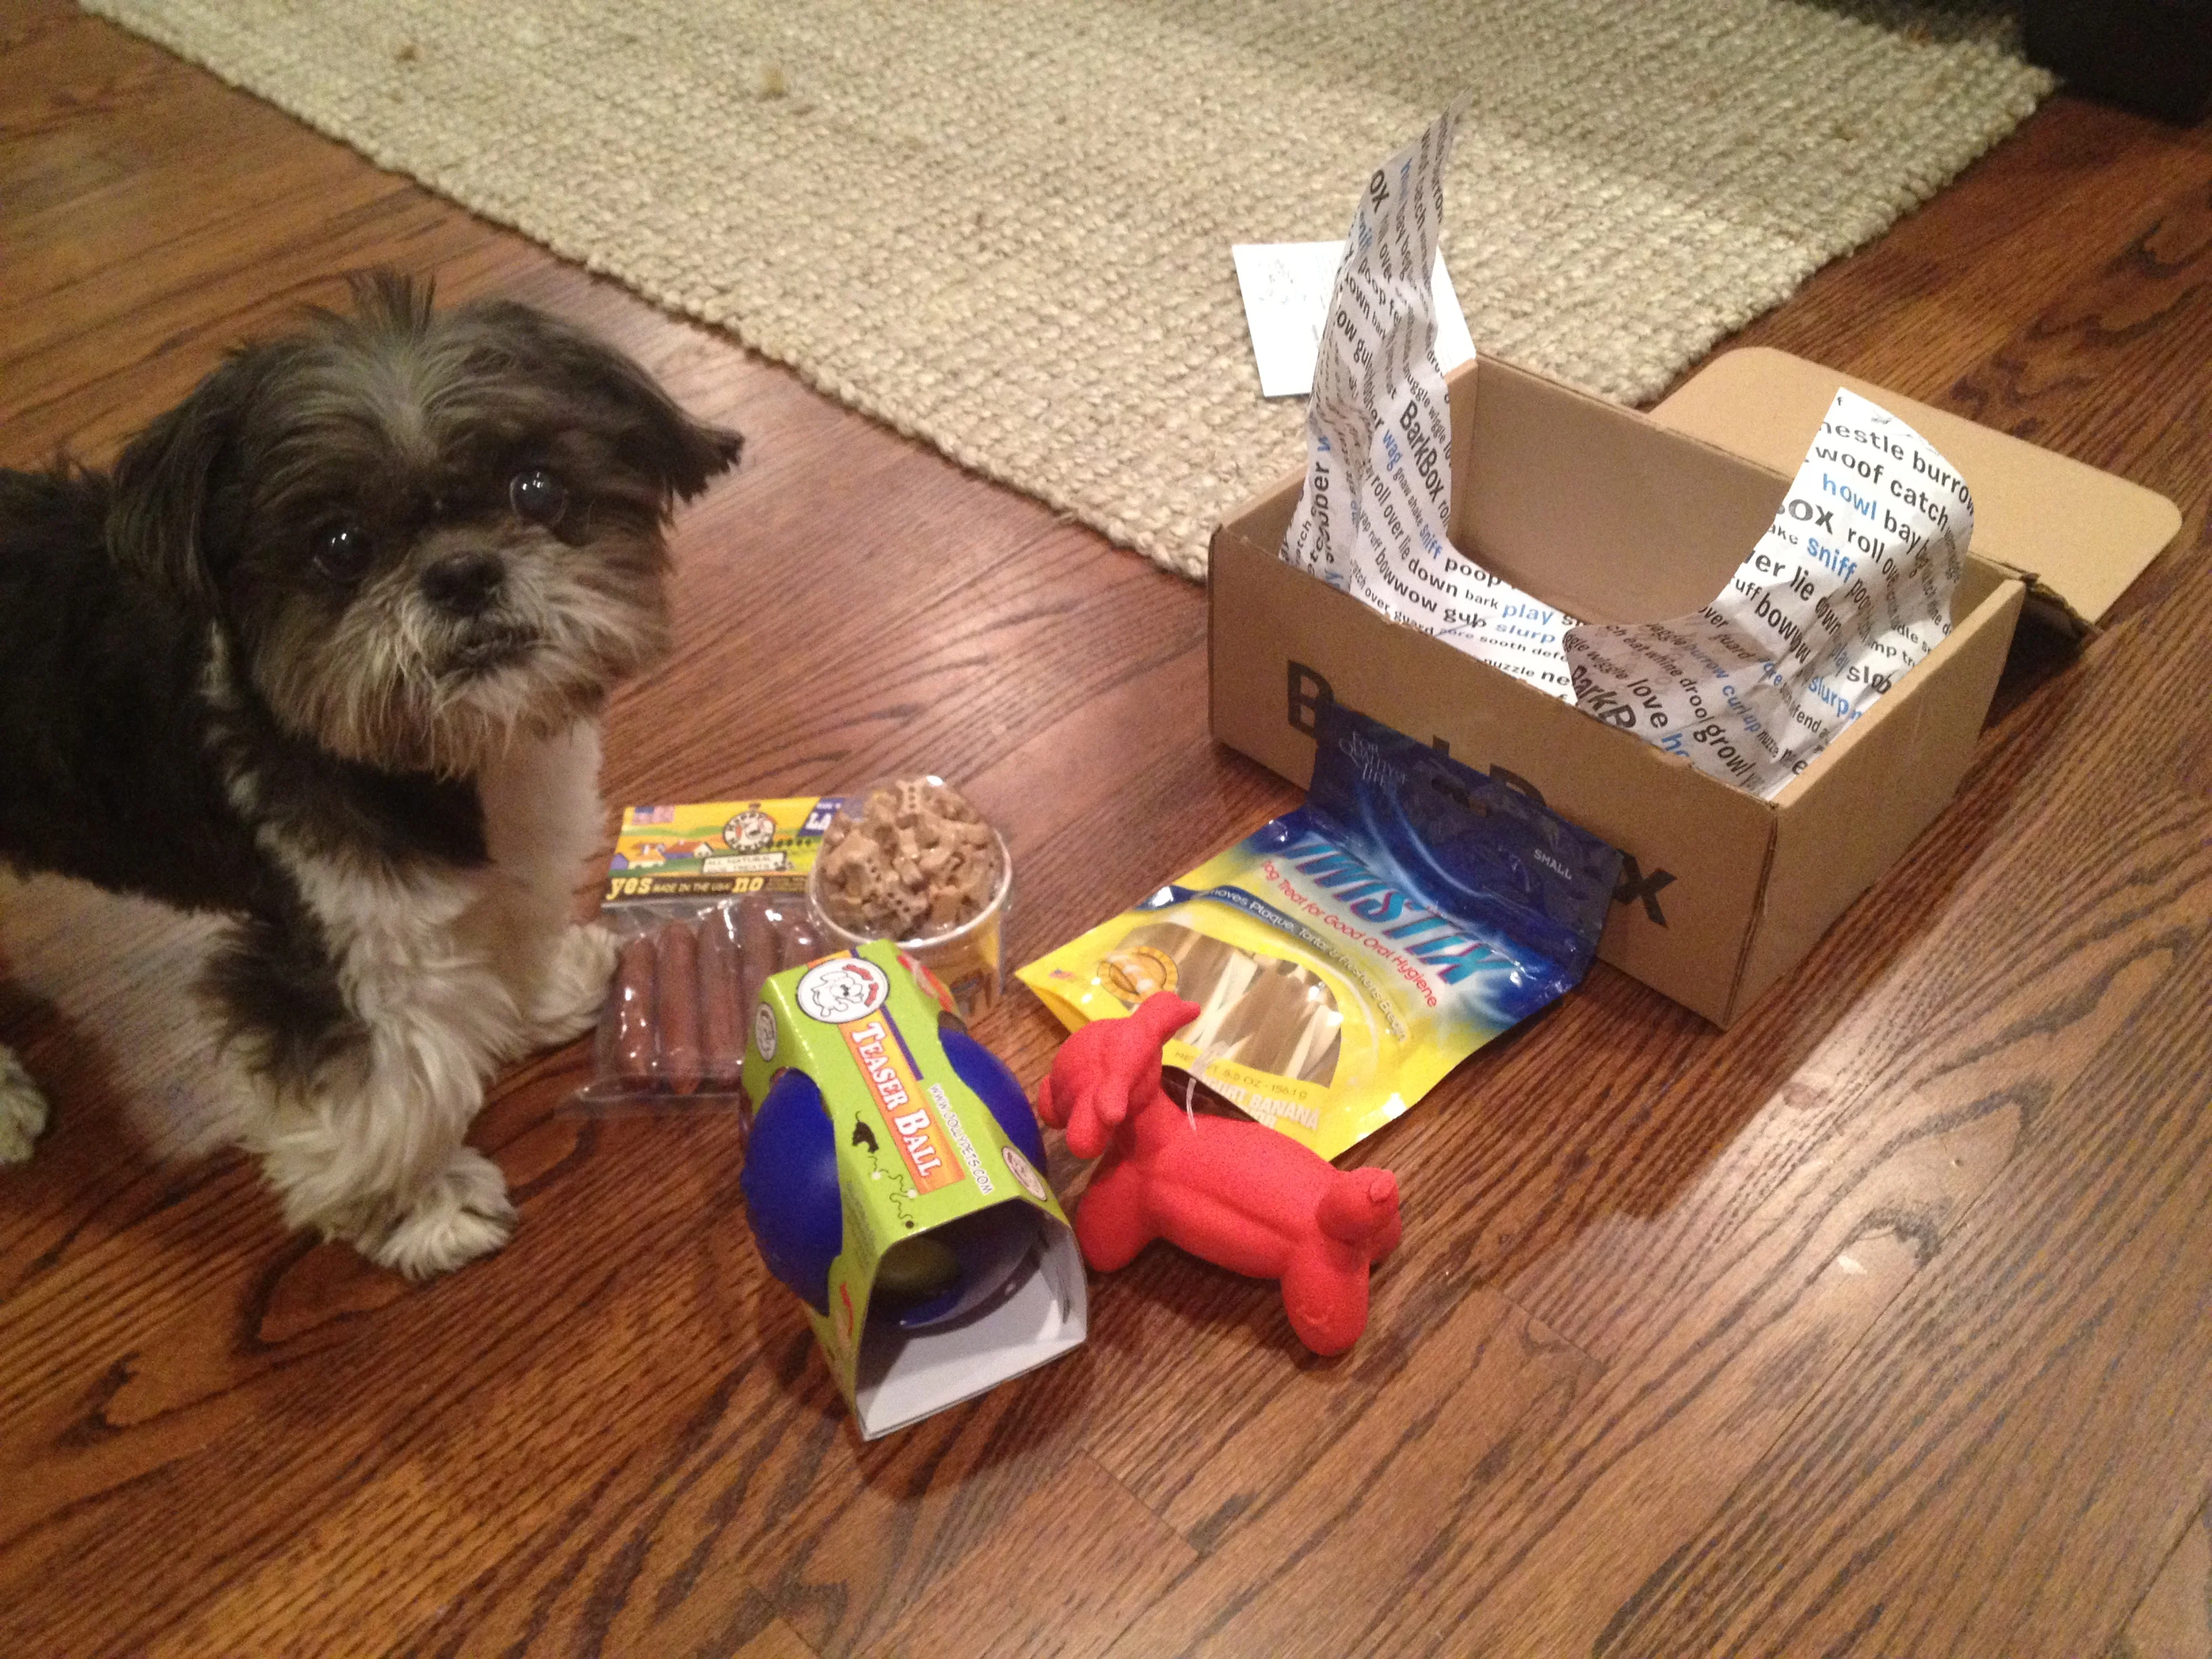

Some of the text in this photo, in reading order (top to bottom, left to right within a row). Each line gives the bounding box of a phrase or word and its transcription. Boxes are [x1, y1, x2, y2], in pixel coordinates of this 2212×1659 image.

[1399, 398, 1444, 504] BarkBox
[1382, 428, 1403, 472] wag
[1393, 466, 1412, 497] gnaw
[1408, 495, 1423, 527] shake
[1420, 523, 1443, 559] sniff
[1445, 557, 1502, 588] poop
[1815, 446, 1949, 531] woof catch
[1822, 472, 1878, 520] howl
[1883, 508, 1922, 554] bay
[1369, 529, 1383, 552] ruff
[1371, 474, 1391, 508] roll
[1382, 504, 1405, 541] over
[1398, 536, 1410, 560] lie
[1408, 557, 1458, 598] down
[1465, 588, 1500, 610] bark
[1501, 602, 1555, 626] play
[1767, 523, 1799, 546] ake
[1806, 537, 1858, 585] sniff
[1847, 527, 1886, 564] roll
[1364, 586, 1391, 612] over
[1374, 549, 1438, 613] bowwow
[1731, 575, 1763, 600] uff
[1790, 566, 1816, 602] lie
[1495, 623, 1557, 644] slurp
[1571, 664, 1637, 729] BarkB
[1626, 678, 1669, 729] love
[1679, 677, 1716, 724] drool
[1807, 676, 1849, 718] slurp
[1692, 723, 1757, 779] growl
[1533, 848, 1573, 881] SMALL
[1278, 878, 1309, 905] Treat
[1301, 902, 1326, 917] for
[1323, 914, 1367, 941] Good
[1363, 937, 1395, 958] Oral
[1391, 955, 1437, 1008] Hygiene
[1248, 1093, 1321, 1131] BANANA
